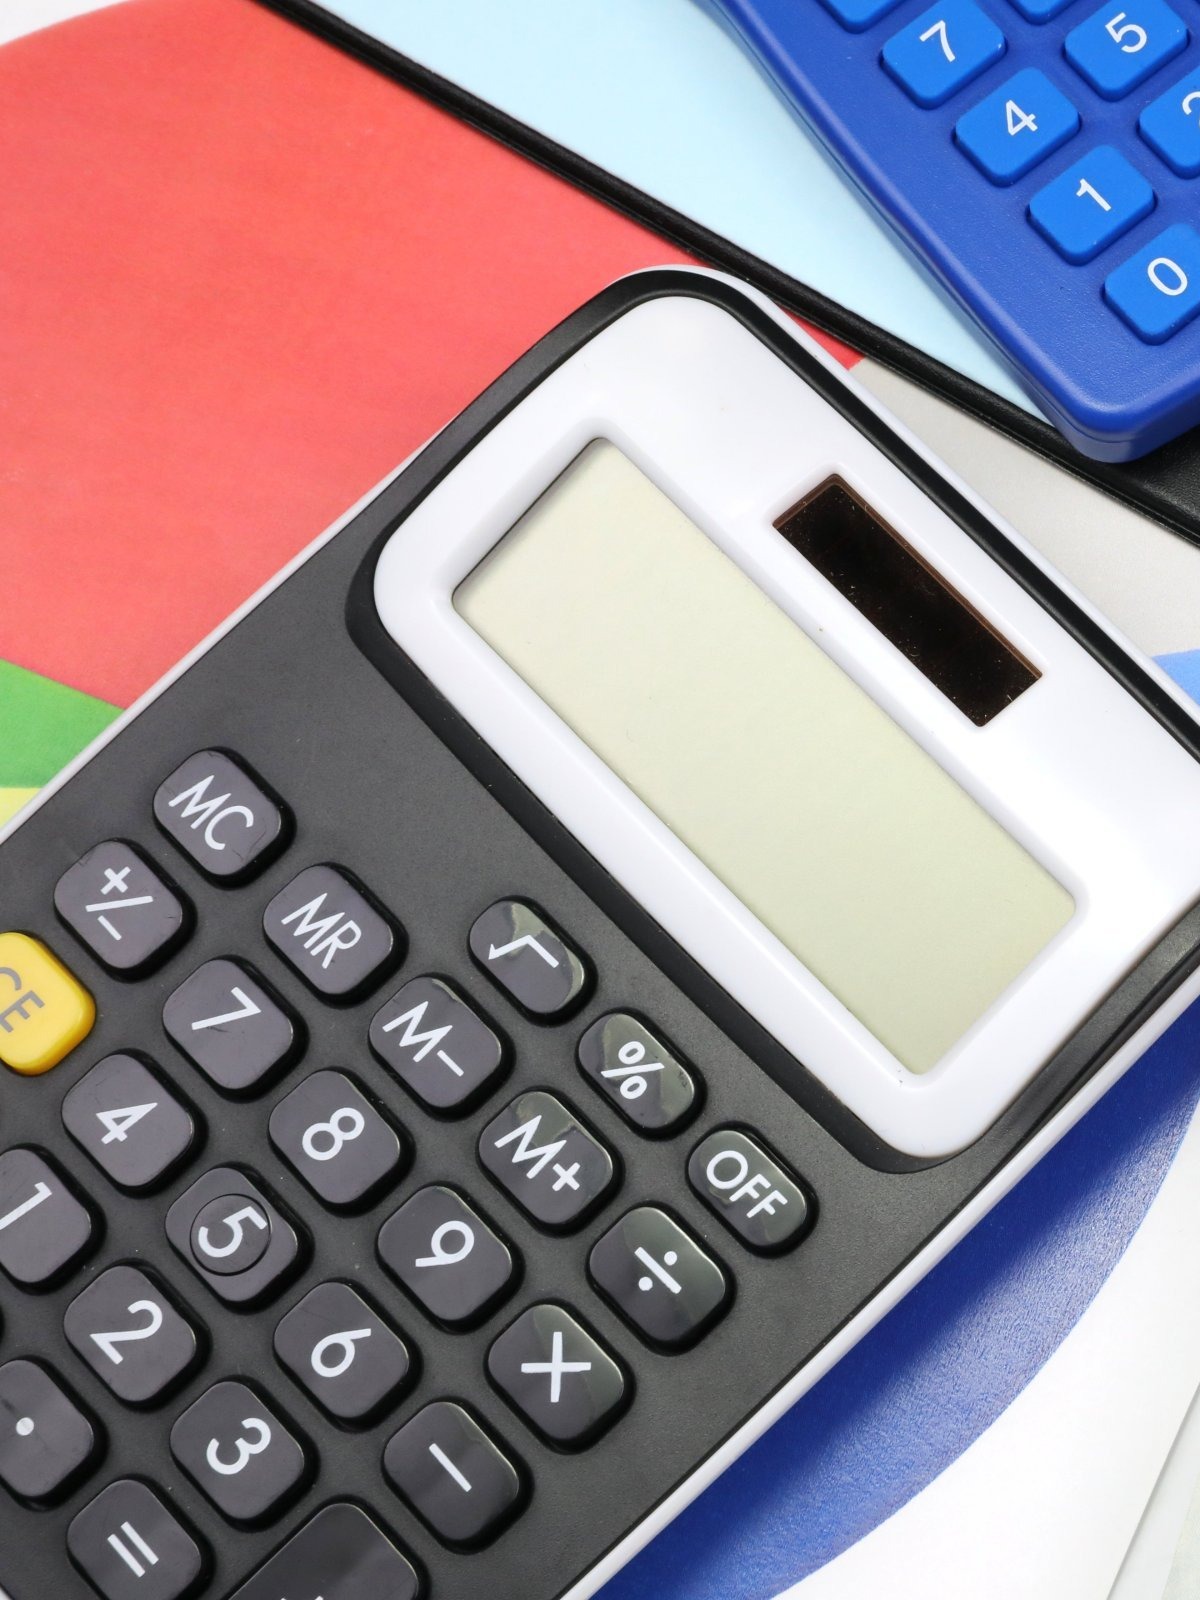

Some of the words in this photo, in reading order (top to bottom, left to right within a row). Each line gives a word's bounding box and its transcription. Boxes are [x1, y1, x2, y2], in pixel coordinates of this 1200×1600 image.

[920, 21, 955, 61] 7
[1106, 13, 1146, 52] 5
[1006, 101, 1037, 135] 4
[1077, 180, 1110, 210] 1
[1148, 258, 1187, 295] 0
[169, 776, 253, 850] MC
[282, 893, 361, 968] MR
[192, 987, 261, 1030] 7
[96, 1103, 157, 1144] 4
[303, 1108, 364, 1160] 8
[707, 1144, 793, 1217] OFF
[199, 1207, 267, 1257] 5
[416, 1221, 474, 1266] 9
[91, 1300, 162, 1364] 2
[207, 1418, 270, 1474] 3
